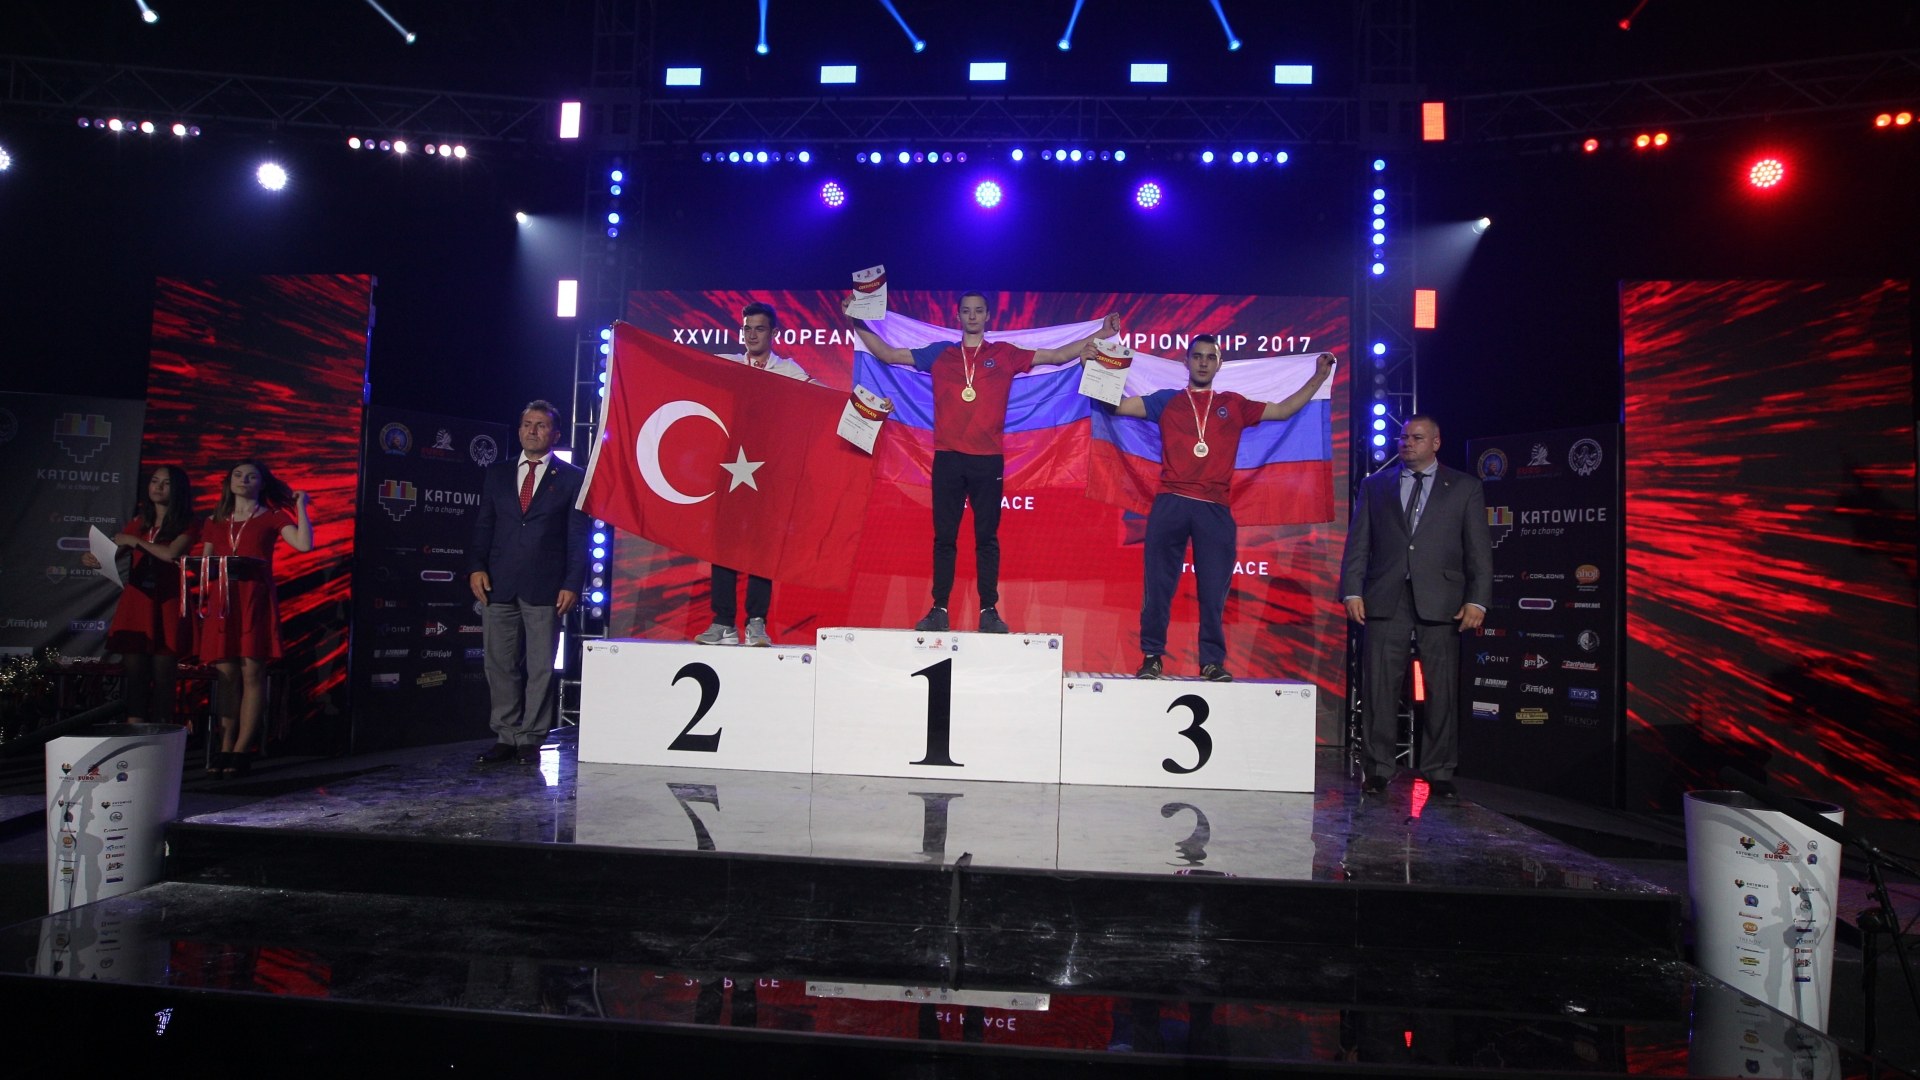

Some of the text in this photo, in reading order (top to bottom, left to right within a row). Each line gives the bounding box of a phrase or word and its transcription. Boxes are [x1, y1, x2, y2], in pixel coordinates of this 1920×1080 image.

[672, 328, 855, 345] XXVII EROPEAN
[1258, 335, 1312, 352] 2017
[36, 469, 121, 483] KATOWICE
[425, 489, 480, 506] KATOWI
[1000, 496, 1035, 510] ACE
[424, 504, 434, 513] for
[440, 506, 465, 516] change
[1521, 507, 1607, 525] KATOWICE
[1520, 528, 1531, 537] for
[1538, 527, 1565, 536] change
[1232, 561, 1269, 575] ACE
[666, 661, 723, 753] 2
[908, 657, 965, 768] 1
[1161, 693, 1213, 774] 3
